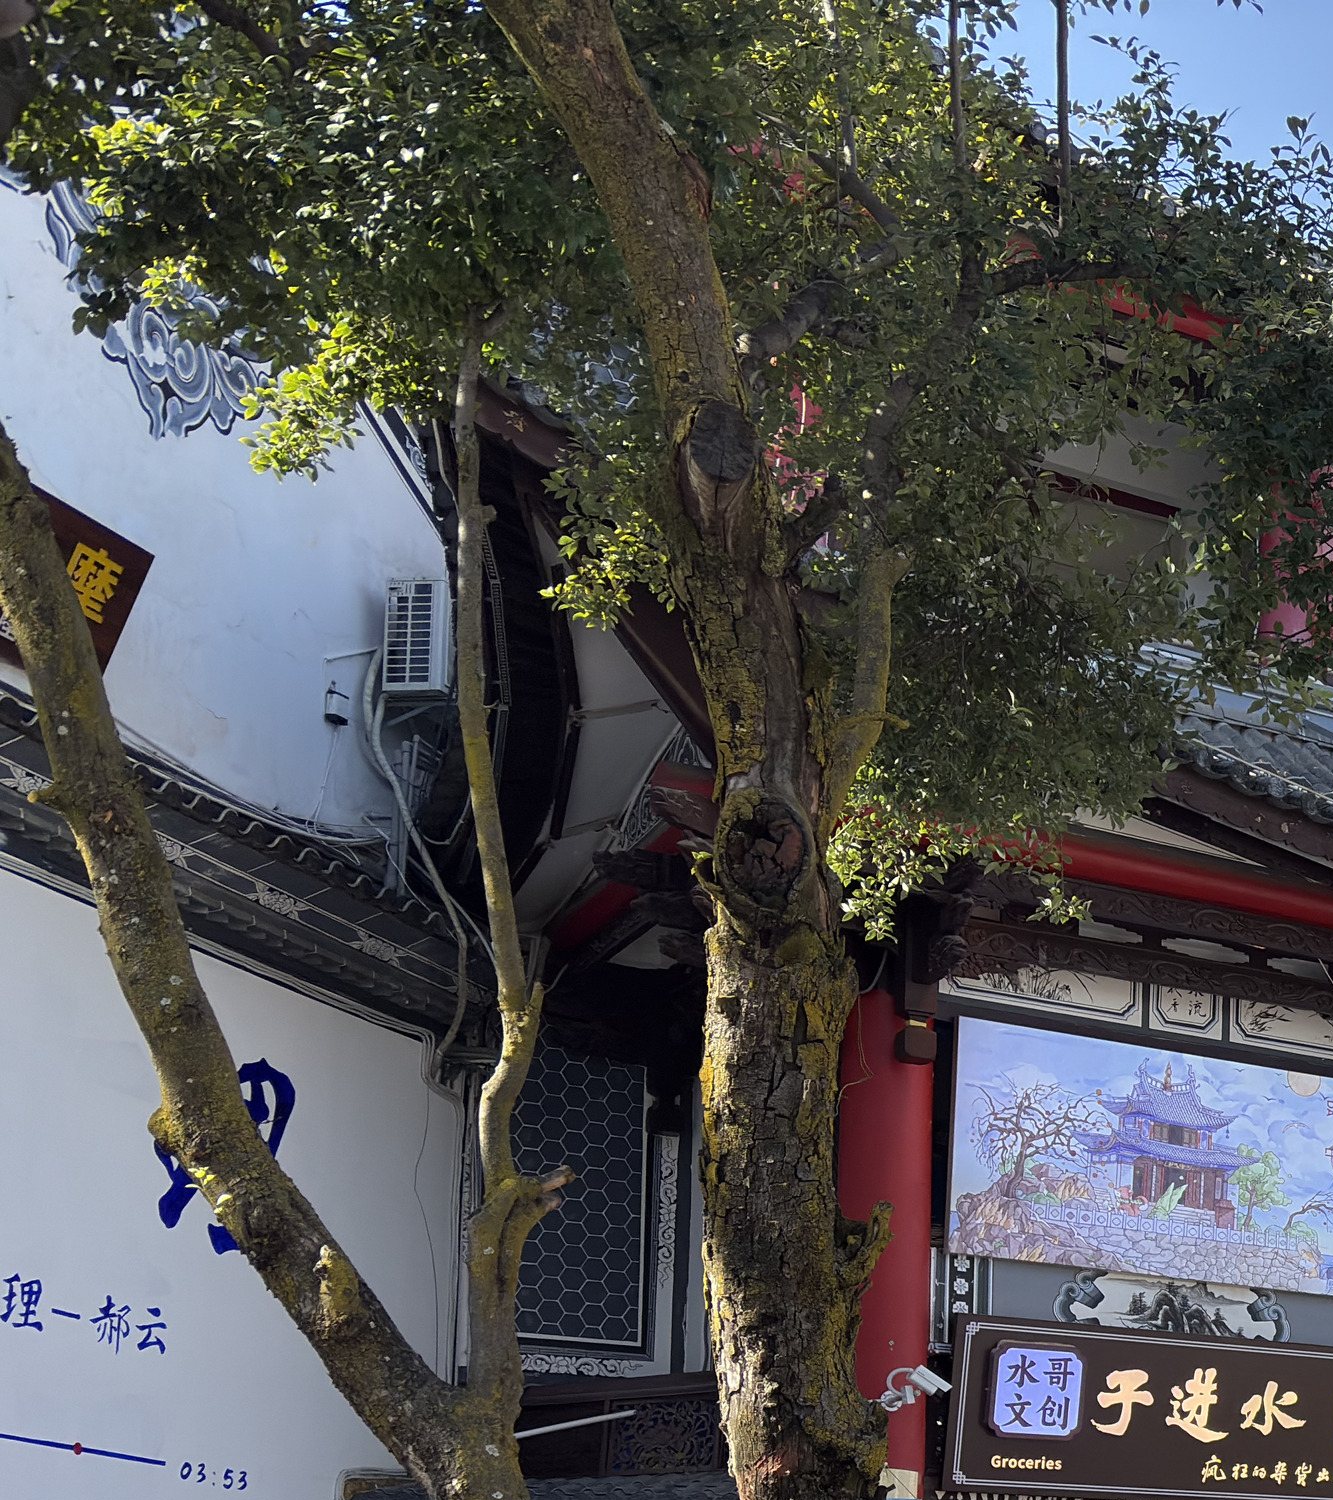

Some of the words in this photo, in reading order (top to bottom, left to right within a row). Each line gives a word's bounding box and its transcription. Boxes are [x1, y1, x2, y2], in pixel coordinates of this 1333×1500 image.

[1005, 1355, 1075, 1391] 水哥
[1004, 1393, 1070, 1431] 文创
[1091, 1367, 1307, 1443] 子进水
[180, 1462, 248, 1491] 03:53
[991, 1454, 1063, 1471] Groceries
